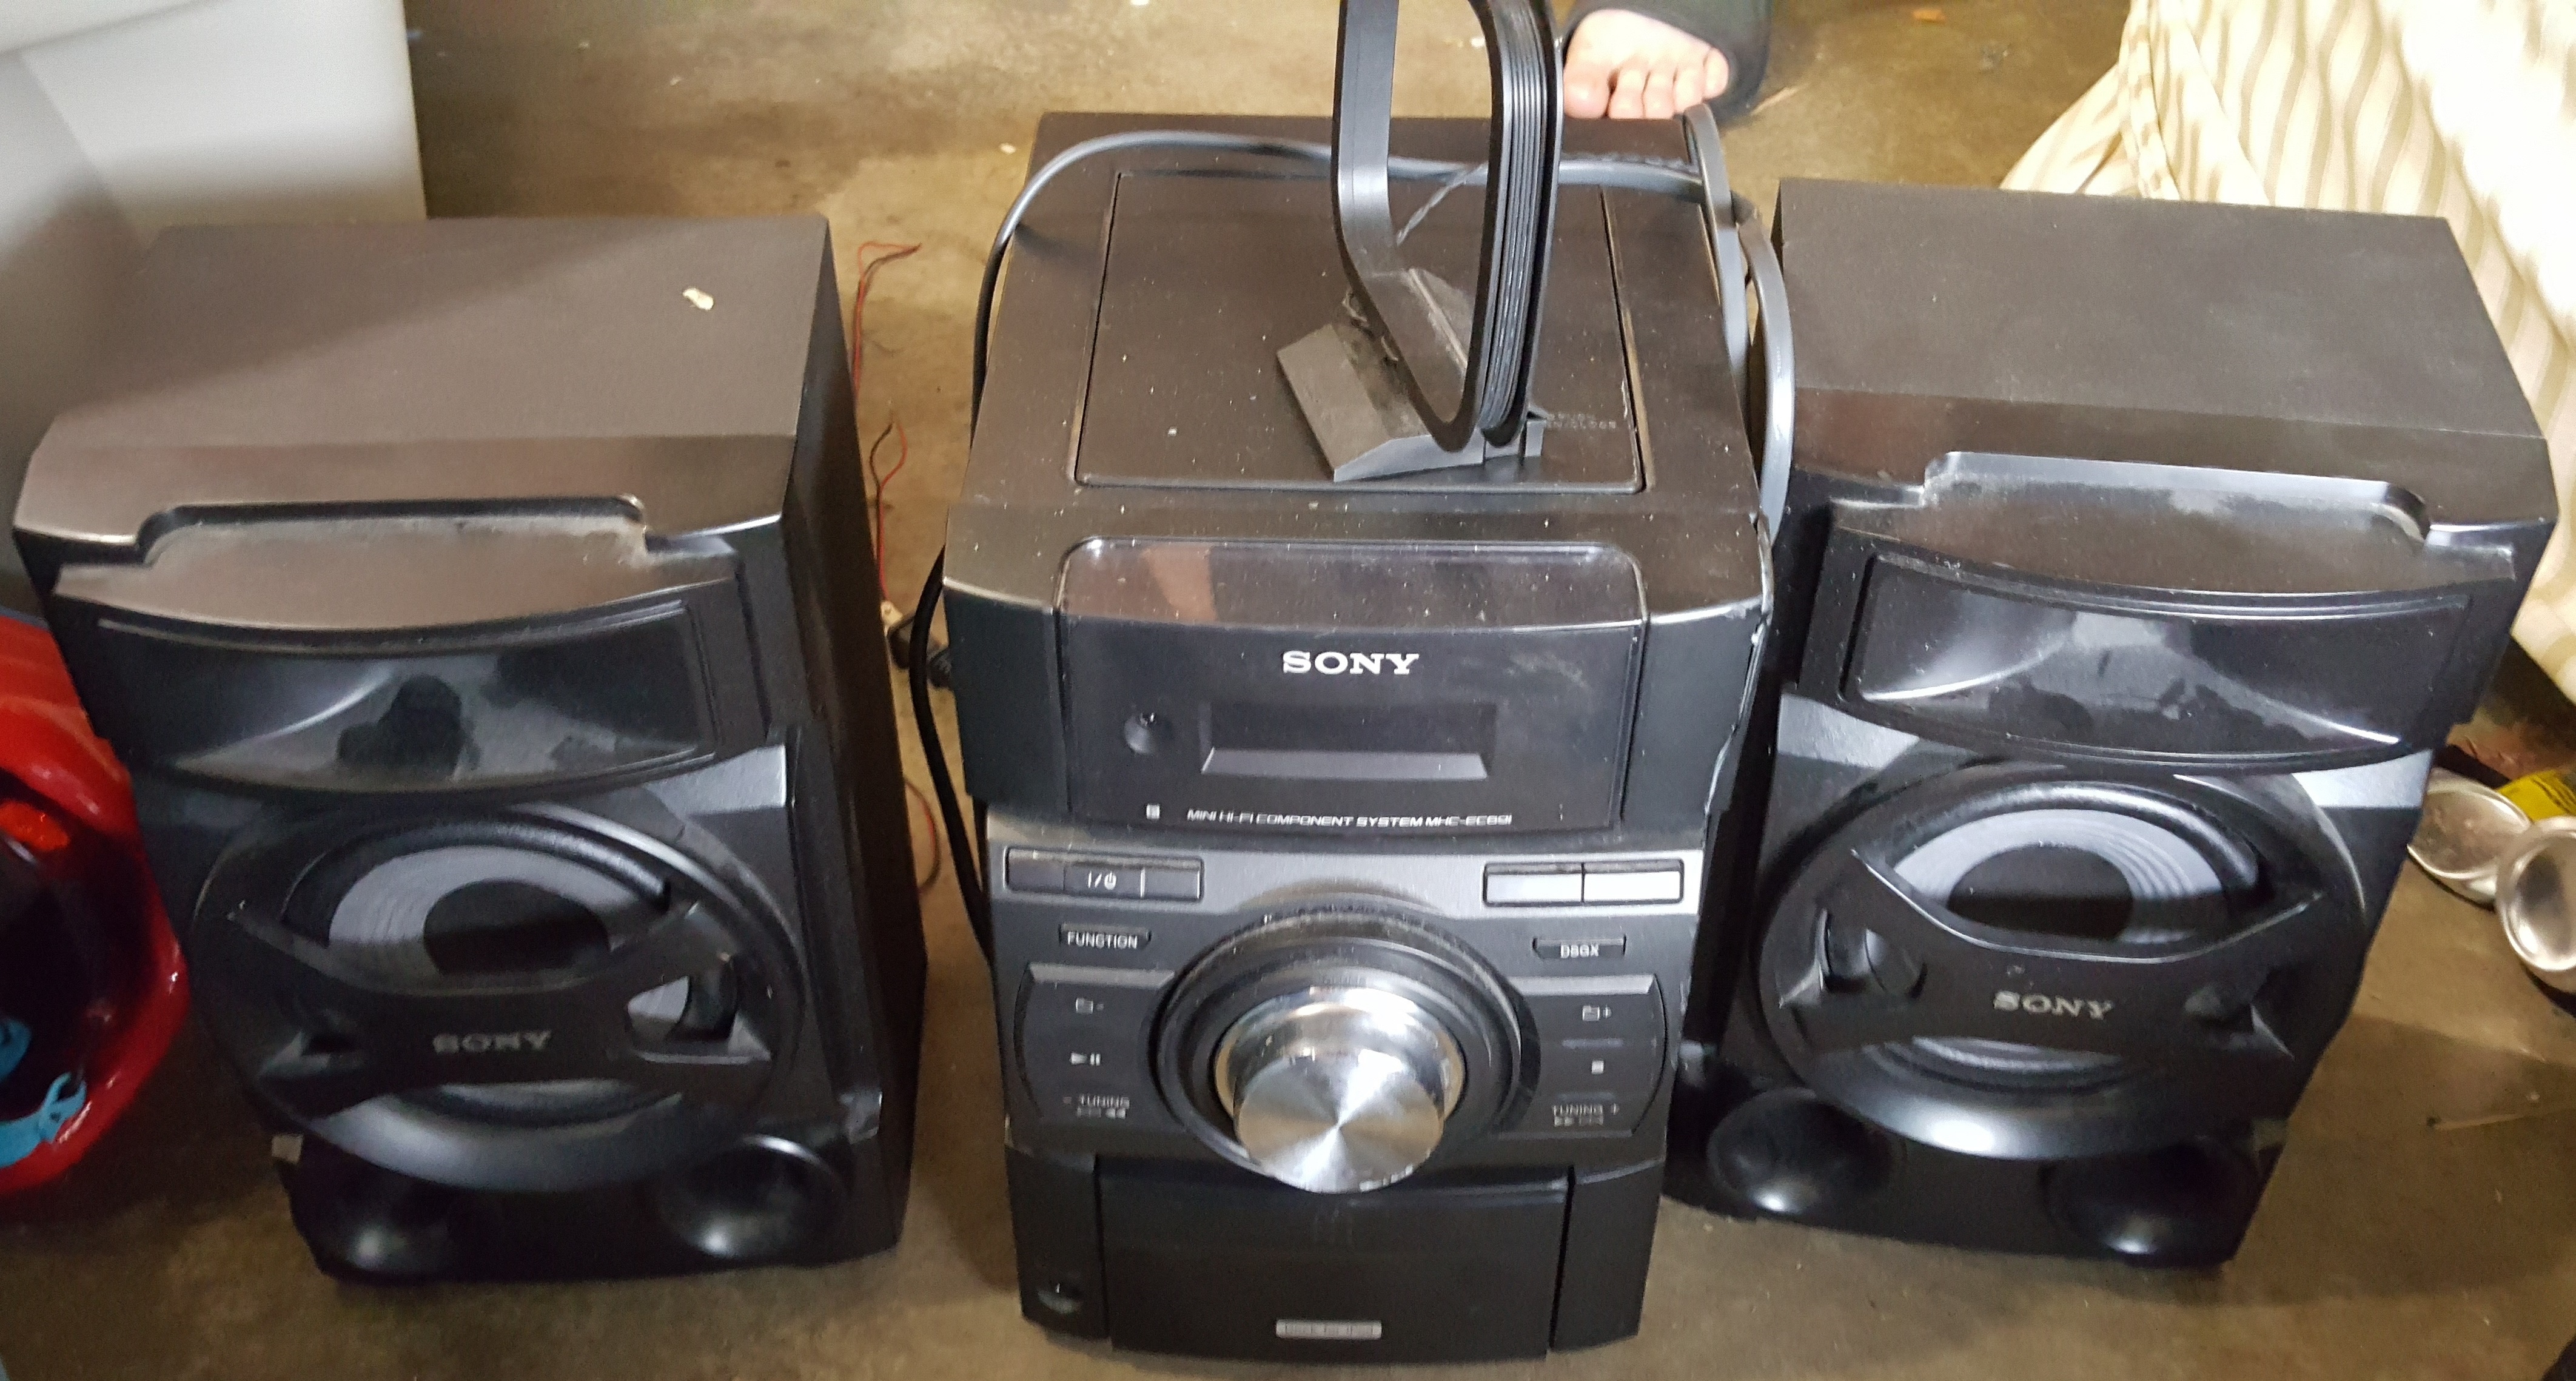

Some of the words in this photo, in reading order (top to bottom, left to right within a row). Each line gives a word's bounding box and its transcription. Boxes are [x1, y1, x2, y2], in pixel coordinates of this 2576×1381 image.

[1283, 650, 1420, 675] SONY
[1187, 808, 1216, 821] MINI
[1256, 813, 1353, 826] COMPONENT
[1357, 816, 1423, 827] SYSTEM
[1068, 932, 1138, 949] FUNCTION
[1993, 990, 2113, 1020] SONY
[433, 1030, 551, 1054] SONY
[1552, 1104, 1603, 1116] TUNING
